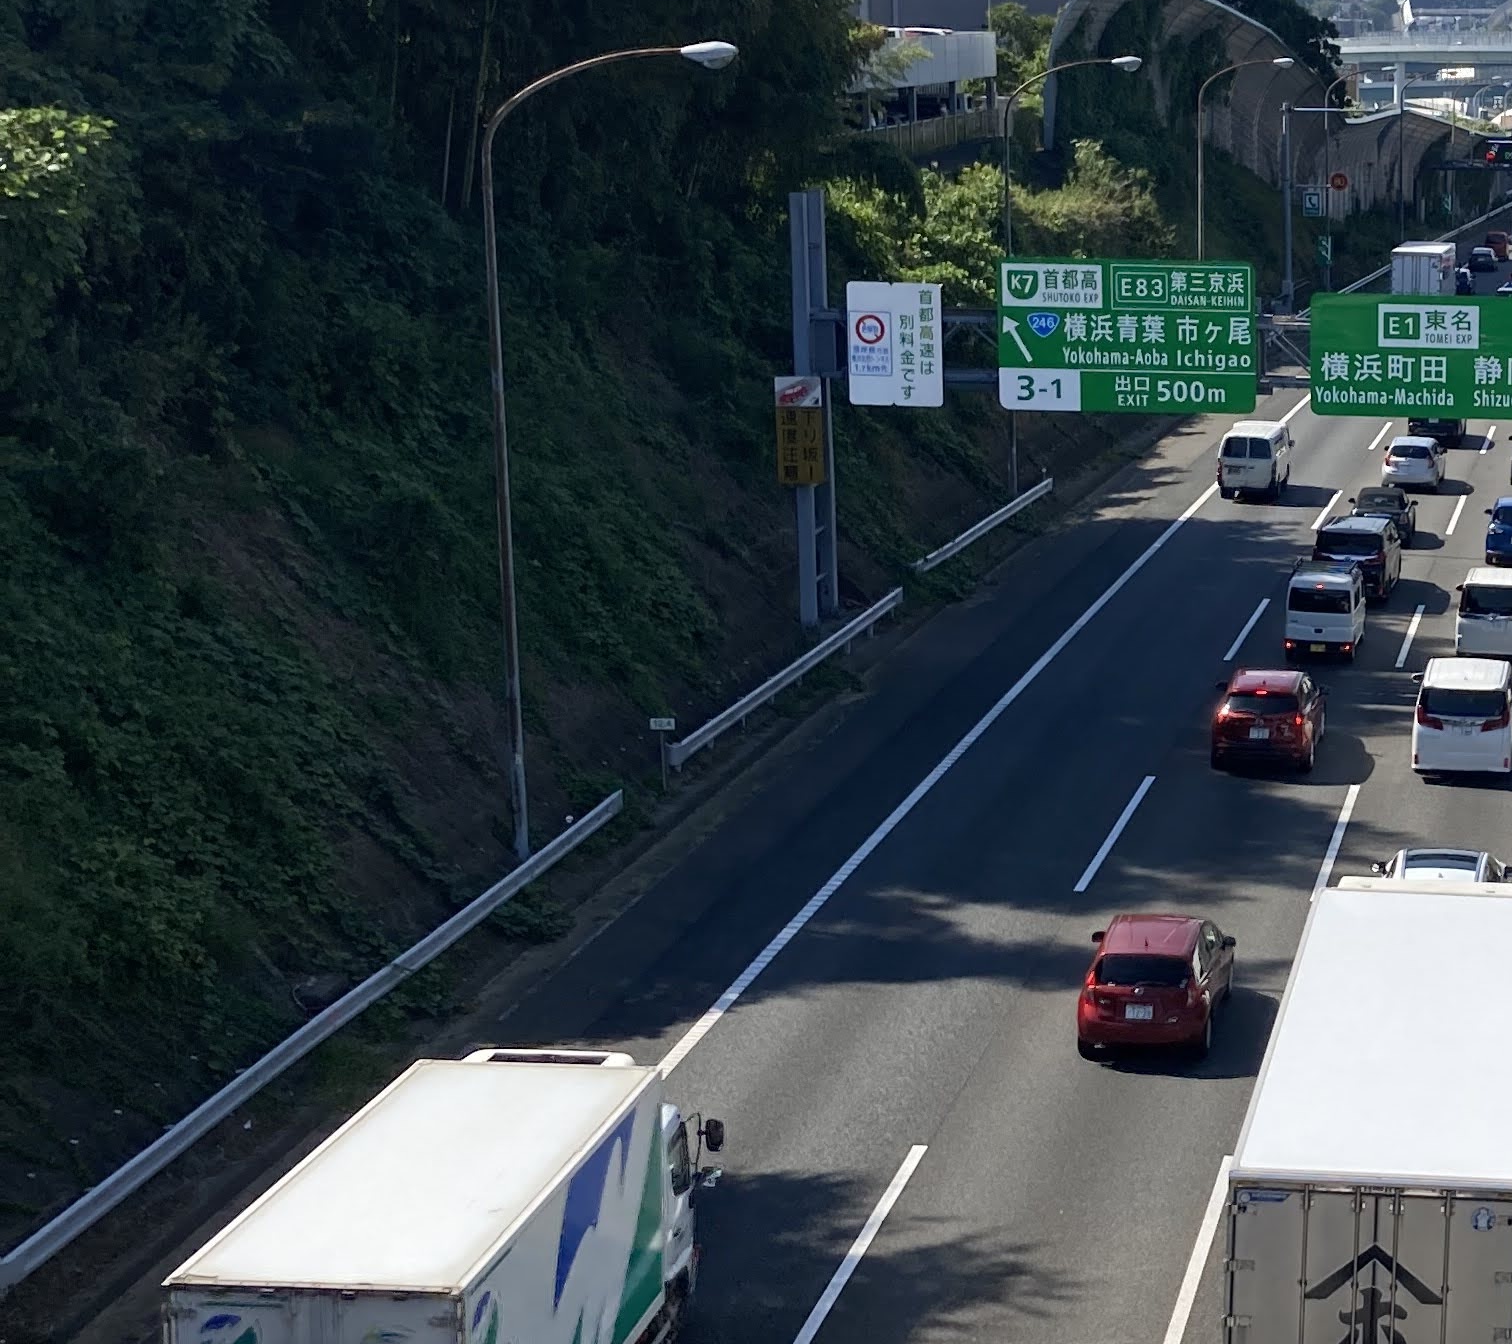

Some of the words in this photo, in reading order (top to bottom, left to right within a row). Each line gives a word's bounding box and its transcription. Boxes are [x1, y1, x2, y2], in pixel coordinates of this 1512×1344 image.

[1011, 274, 1034, 294] K7
[1043, 269, 1098, 291] 首都高
[1121, 278, 1164, 297] E83
[1170, 271, 1244, 294] 第三京浜
[1042, 292, 1081, 303] SHUTOKO
[1083, 293, 1099, 304] EXP
[1170, 294, 1245, 307] DAISAN-KEIHIN
[1032, 316, 1056, 330] 246
[1063, 312, 1166, 344] 横浜青葉
[1388, 317, 1414, 335] E1
[1424, 309, 1472, 332] 東名
[918, 289, 935, 376] 首都高速は
[1425, 333, 1452, 344] TOMEI
[1456, 334, 1473, 344] EXP
[899, 314, 916, 400] 別料金です
[1063, 346, 1168, 366] Yokohama-Aoba
[1177, 349, 1251, 372] Ichigao
[1320, 351, 1447, 384] 横浜町田
[1017, 375, 1062, 401] 3-1
[1114, 375, 1150, 392] 出口
[1157, 380, 1226, 403] 500m
[1117, 394, 1149, 407] EXIT
[1314, 385, 1455, 407] Yokohama-Machida
